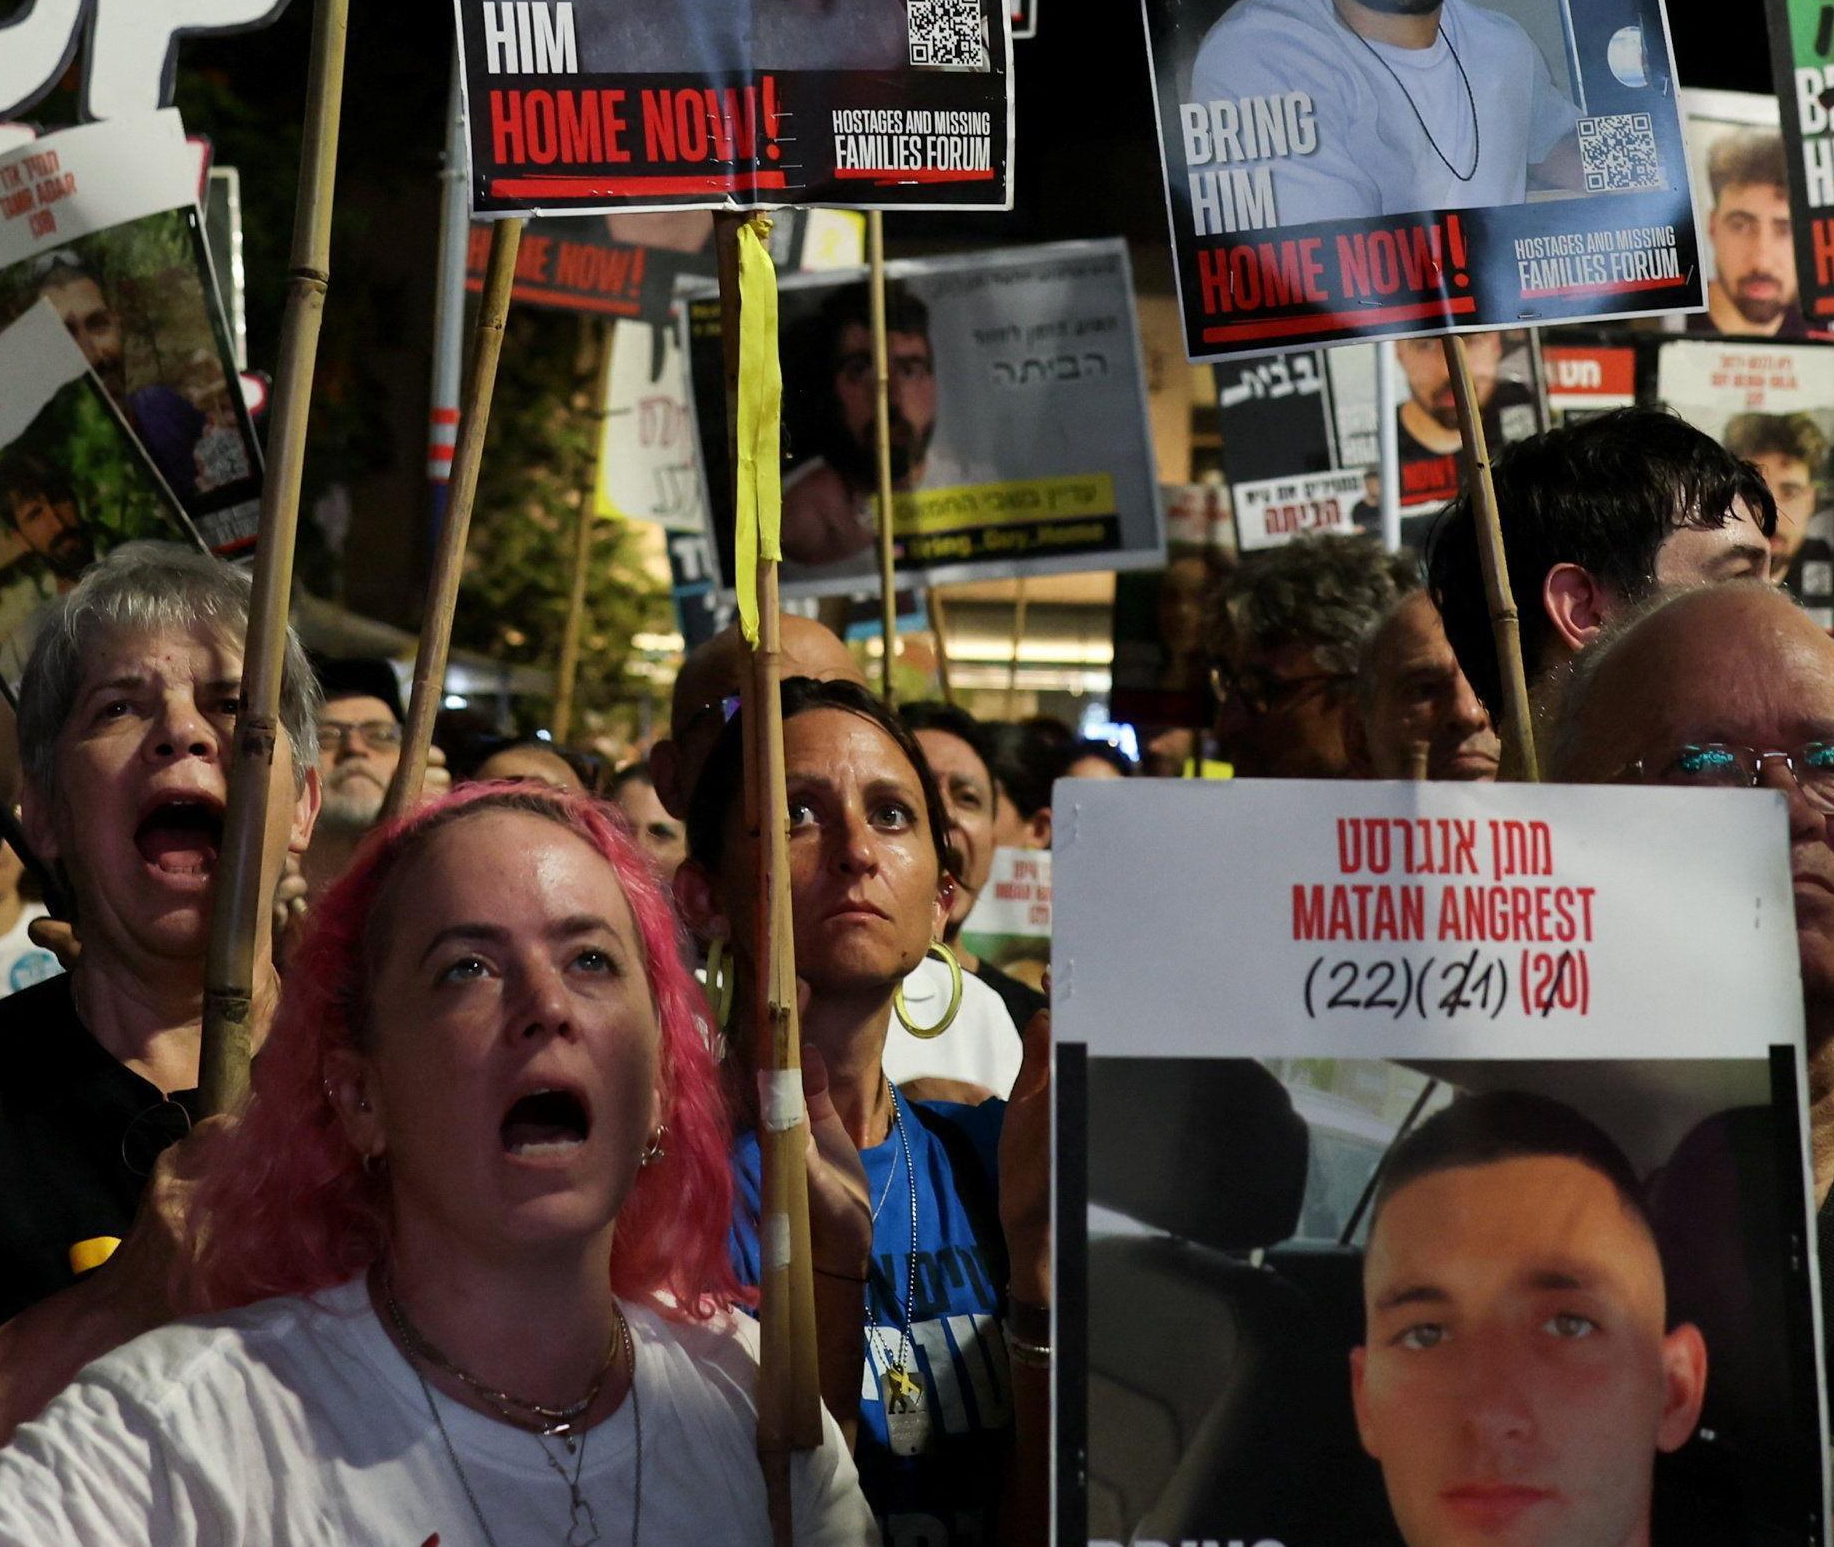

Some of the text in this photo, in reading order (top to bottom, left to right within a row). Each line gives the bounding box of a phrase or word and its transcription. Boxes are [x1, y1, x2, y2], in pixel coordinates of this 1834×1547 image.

[483, 0, 578, 74] HIM
[489, 75, 782, 165] HOME NOW!
[832, 109, 991, 136] HOSTAGES AND MISSING
[1180, 89, 1318, 168] BRING
[834, 134, 992, 172] FAMILIES FORUM
[1187, 161, 1278, 238] HIM
[1198, 215, 1471, 316] HOME NOW!
[1514, 224, 1676, 261] HOSTAGES AND MISSING
[1517, 245, 1680, 293] FAMILIES FORUM
[1335, 817, 1554, 882] מתן אנגרסט
[1292, 884, 1597, 944] MATAN ANGREST
